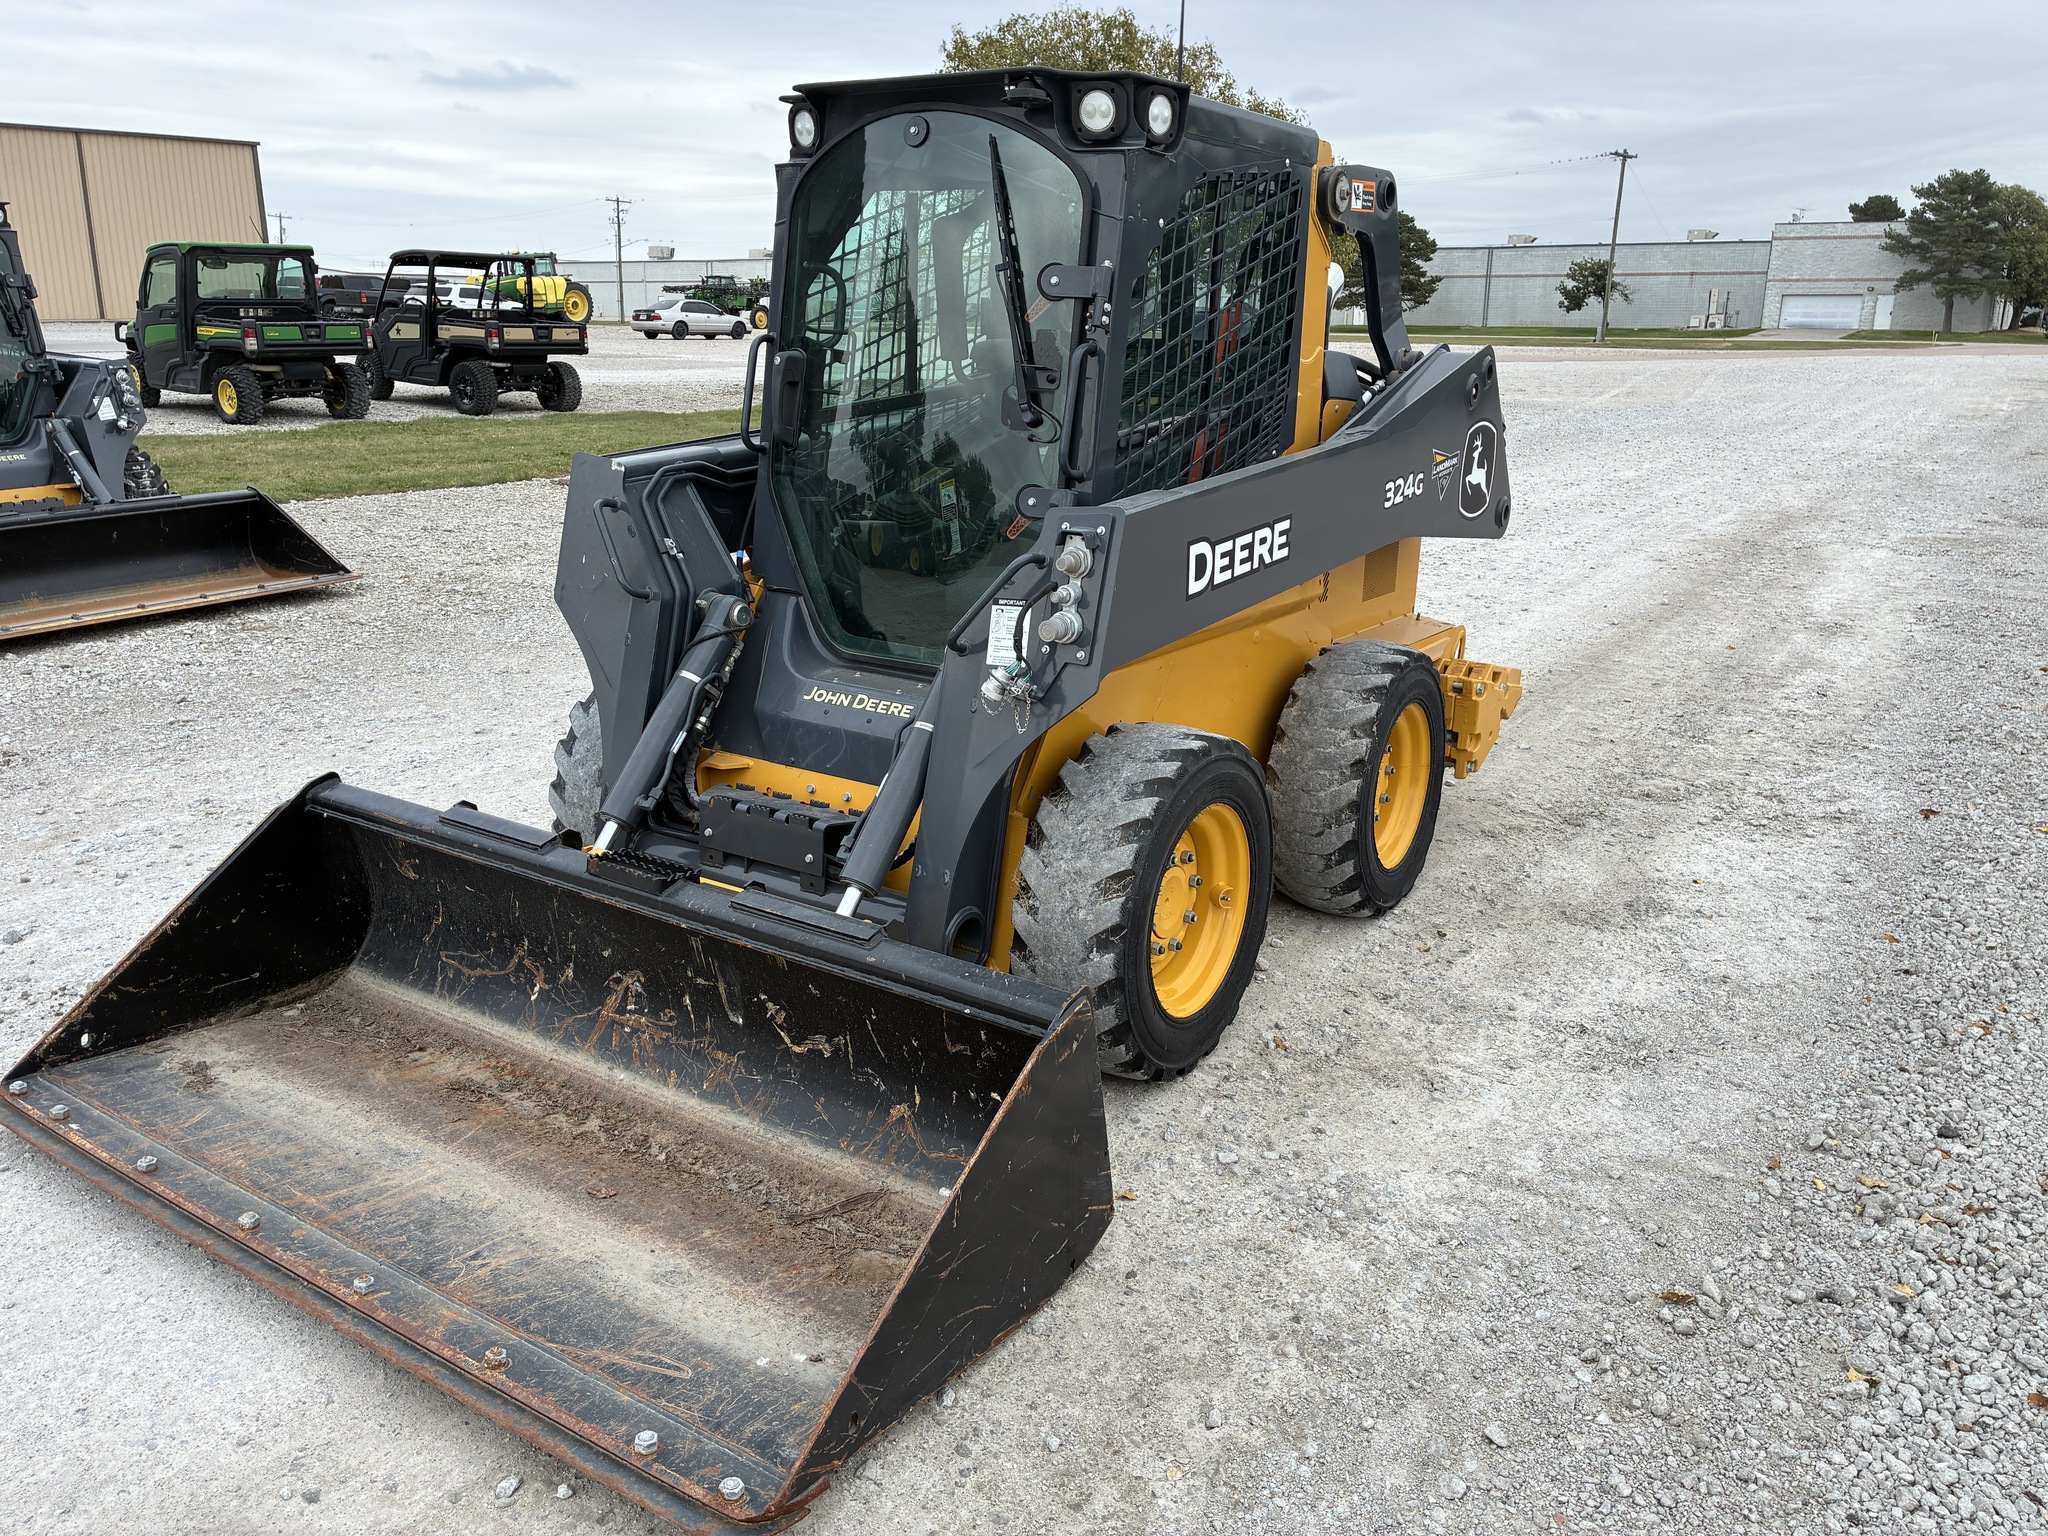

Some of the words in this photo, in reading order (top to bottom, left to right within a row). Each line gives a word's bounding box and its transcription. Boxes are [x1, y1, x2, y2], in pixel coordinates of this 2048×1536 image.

[1384, 472, 1424, 508] 324G
[1188, 519, 1291, 596] DEERE
[803, 686, 852, 707] JOHN
[851, 693, 915, 718] DEERE
